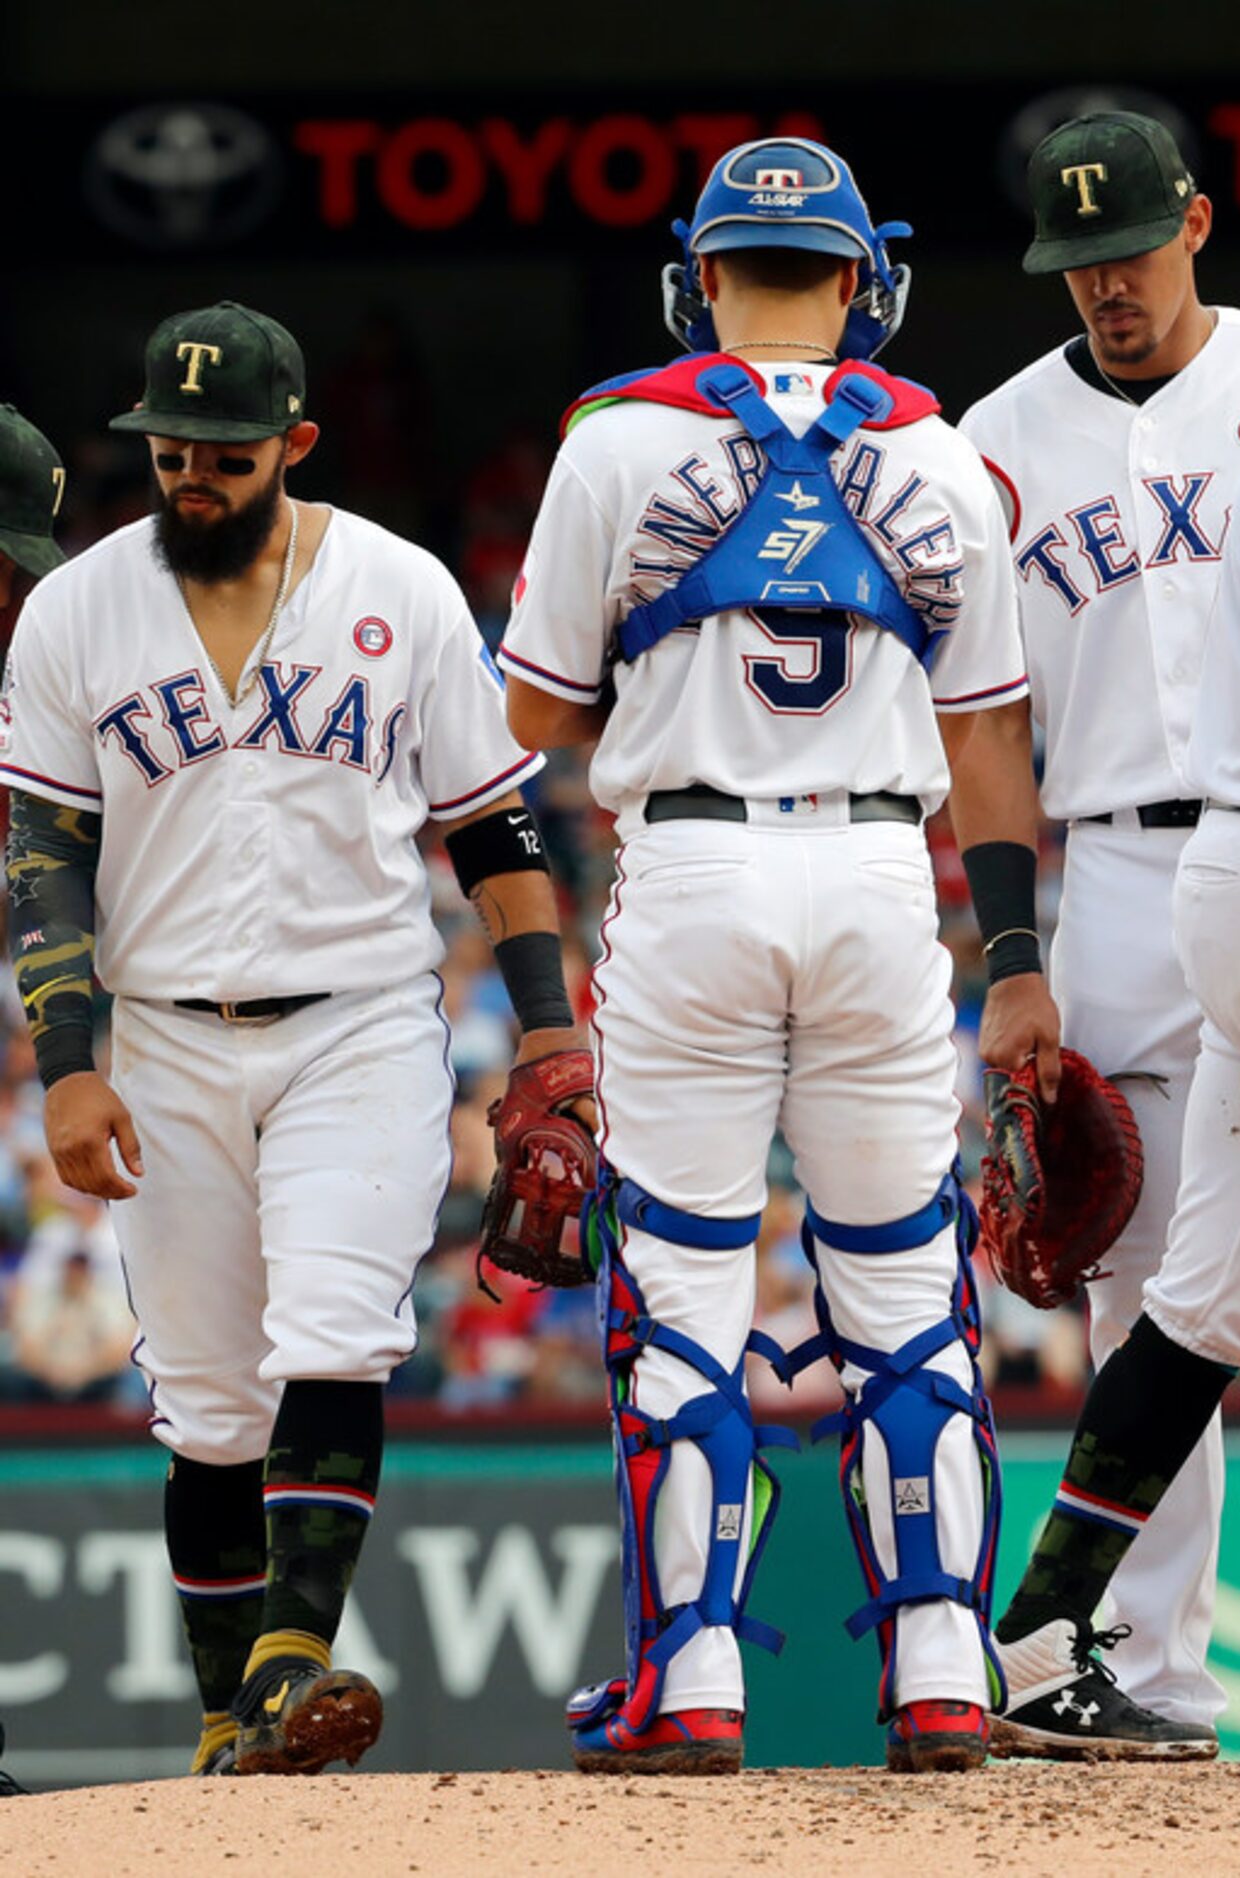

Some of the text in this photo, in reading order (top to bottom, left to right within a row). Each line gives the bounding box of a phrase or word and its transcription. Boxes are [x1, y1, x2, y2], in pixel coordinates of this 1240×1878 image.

[300, 112, 828, 231] TOYOT
[1061, 163, 1106, 215] T
[177, 342, 222, 394] T
[1013, 472, 1233, 618] TEX
[517, 829, 541, 854] 12
